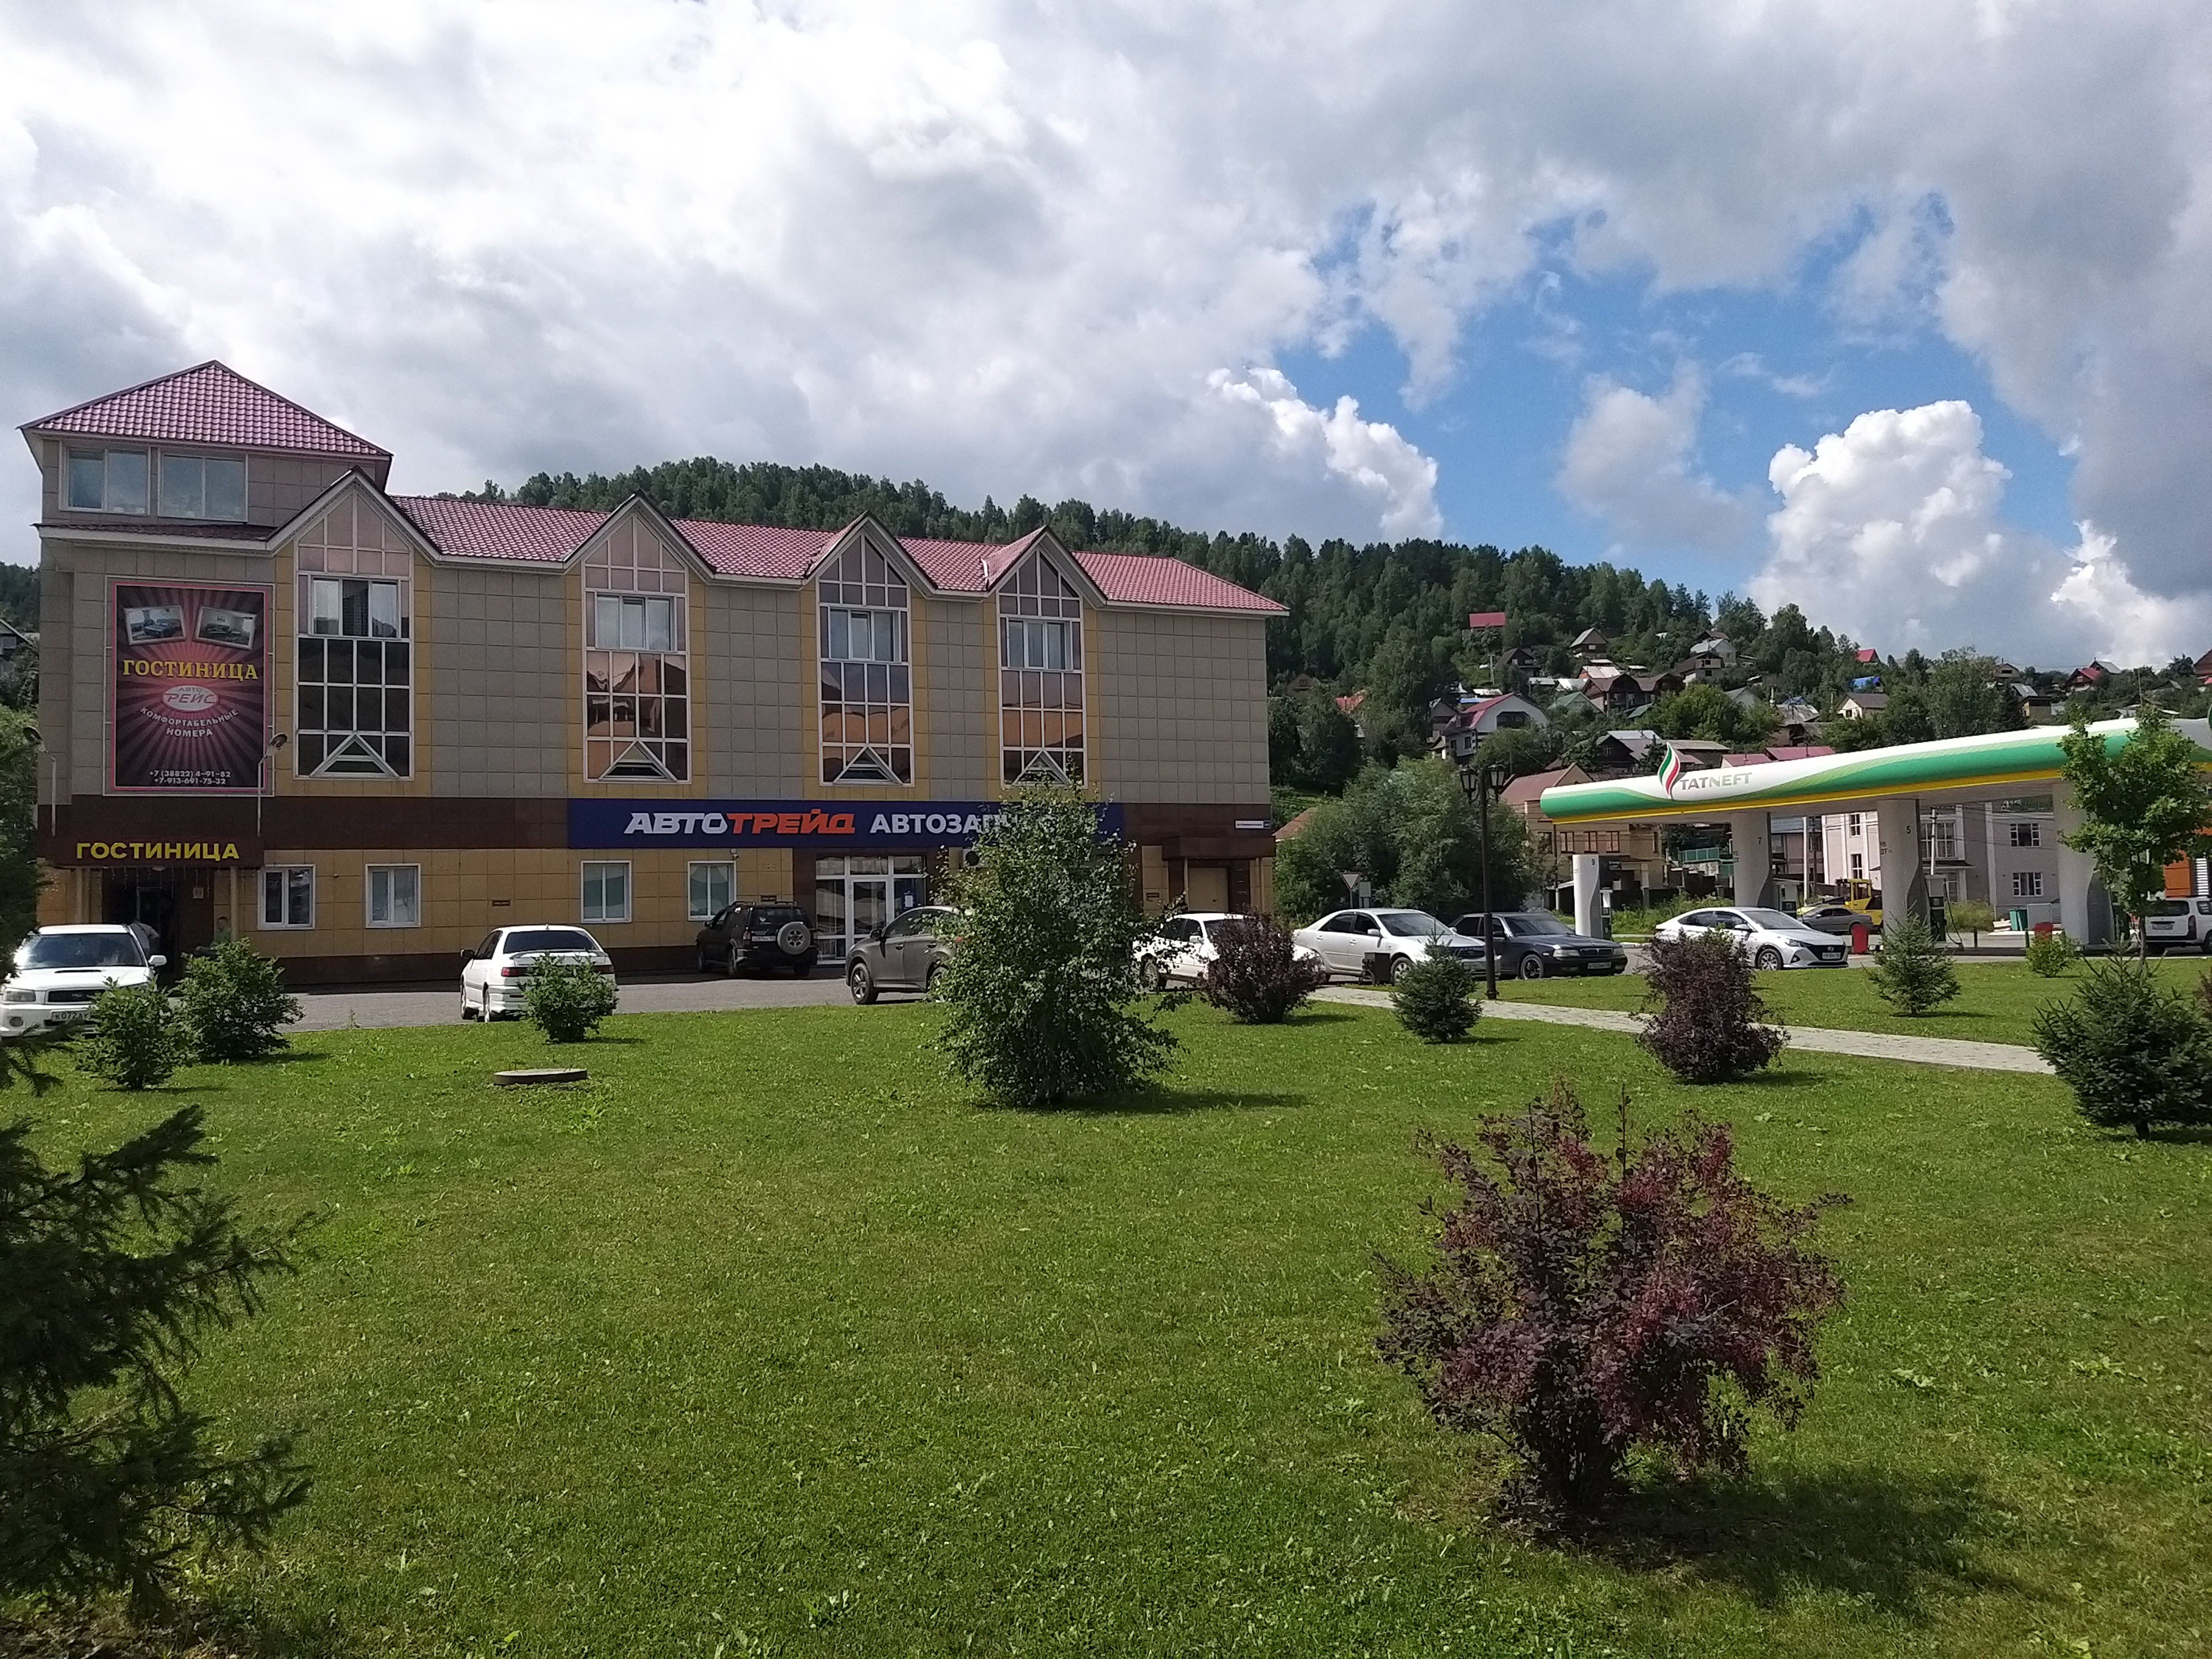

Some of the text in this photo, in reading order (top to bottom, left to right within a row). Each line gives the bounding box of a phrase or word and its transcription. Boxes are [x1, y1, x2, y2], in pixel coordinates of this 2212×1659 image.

[123, 659, 259, 681] ГОСТИНИЦА
[165, 693, 216, 703] РЕЙС
[140, 706, 239, 727] КОМФОРТАБЕЛЬНЫЕ
[166, 728, 213, 737] НОМЕРА
[1680, 773, 1752, 790] TATNEFT
[623, 809, 855, 834] АВТОТРЕЙД
[1906, 825, 1911, 834] 5
[77, 842, 240, 861] ГОСТИНИЦА
